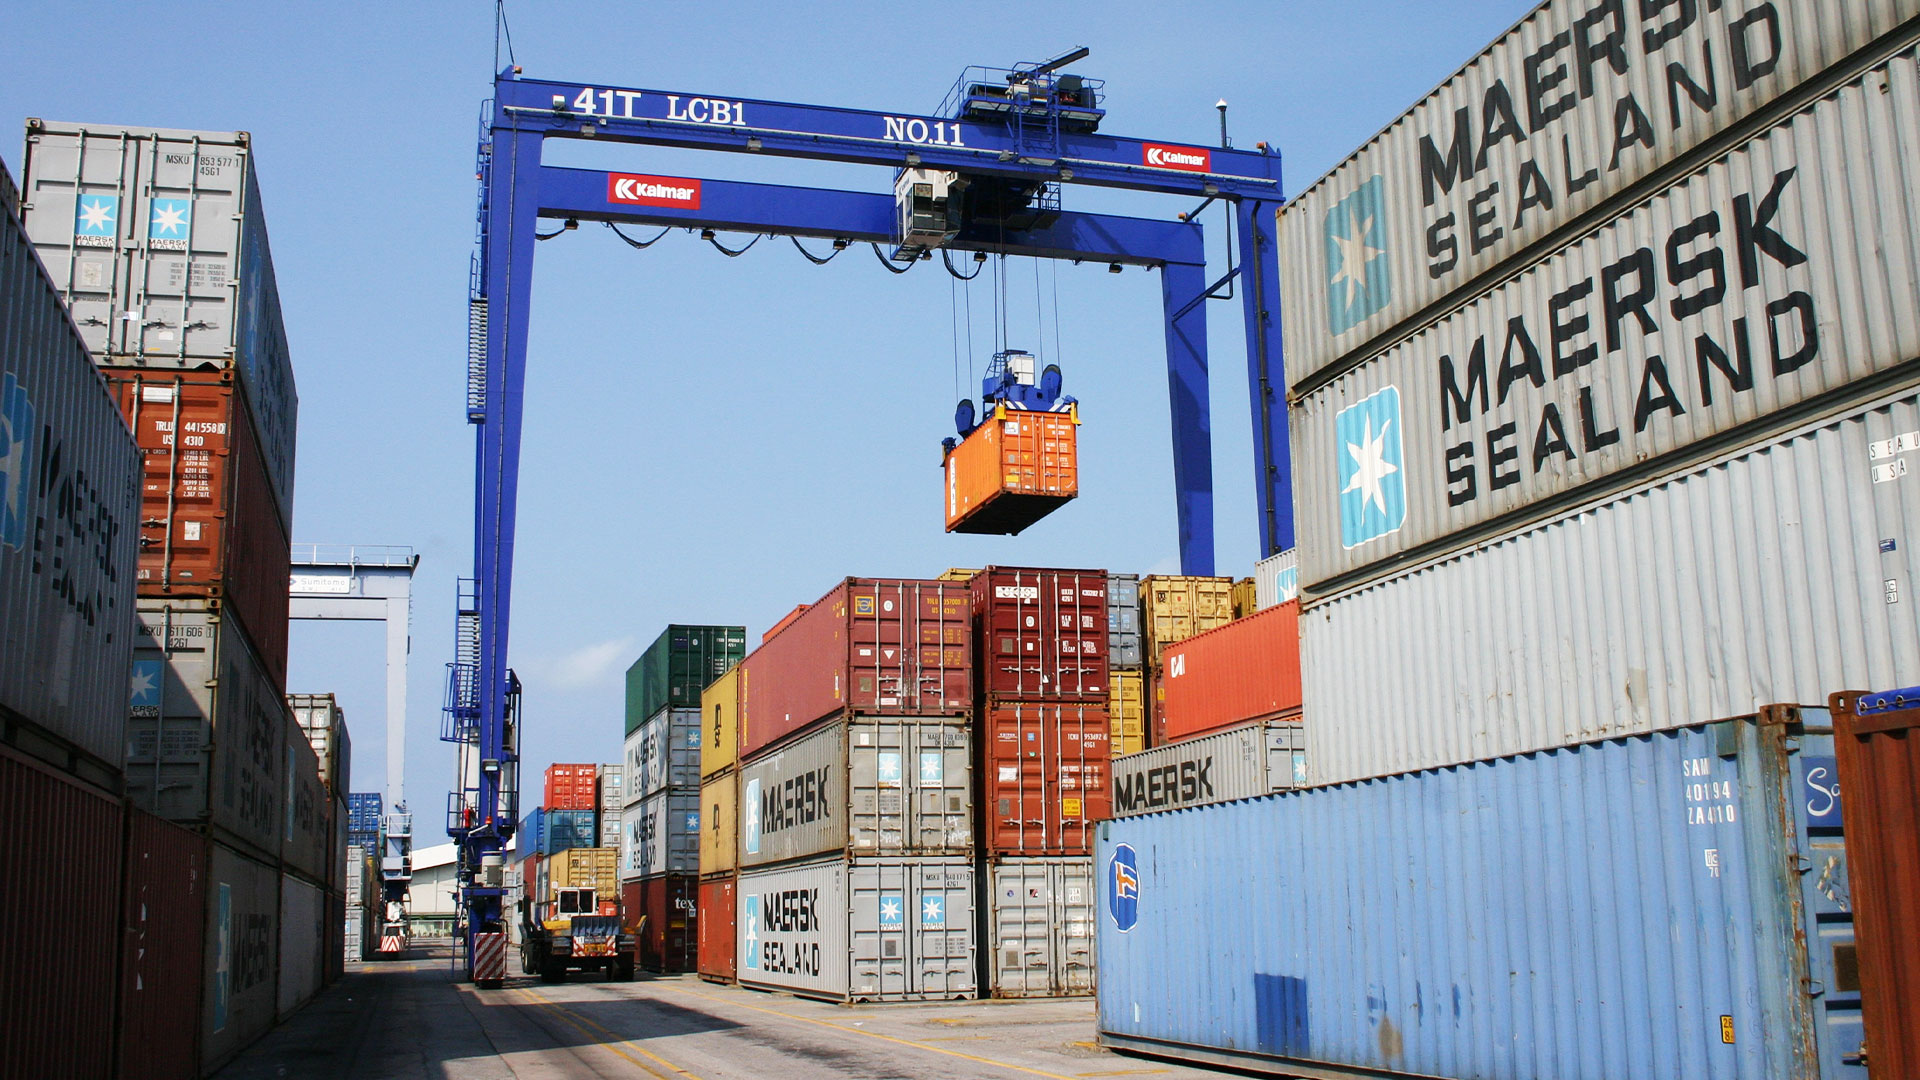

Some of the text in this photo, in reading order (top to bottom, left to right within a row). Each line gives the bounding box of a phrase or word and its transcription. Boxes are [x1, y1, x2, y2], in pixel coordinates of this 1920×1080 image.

[574, 88, 746, 126] 41T LCB1
[1419, 0, 1721, 207] MAERS
[883, 117, 964, 146] NO.11
[1427, 1, 1781, 280] SEALAND
[166, 155, 190, 164] MSKU
[200, 157, 215, 166] 853
[217, 158, 232, 167] 577
[1163, 151, 1205, 166] Kalmar
[200, 167, 220, 176] 45G1
[636, 182, 694, 200] Kalmar
[1440, 166, 1807, 433] MAERSK
[1446, 291, 1819, 508] SEALAND
[155, 421, 174, 432] TRLU
[184, 436, 204, 446] 4310
[1873, 460, 1906, 481] USA
[139, 626, 162, 636] MSKU
[1683, 758, 1710, 776] SAM
[1114, 756, 1214, 813] MAERSK
[762, 764, 831, 834] MAERSK
[675, 897, 695, 909] tex
[764, 888, 819, 931] MAERSK
[764, 941, 820, 977] SEALAND
